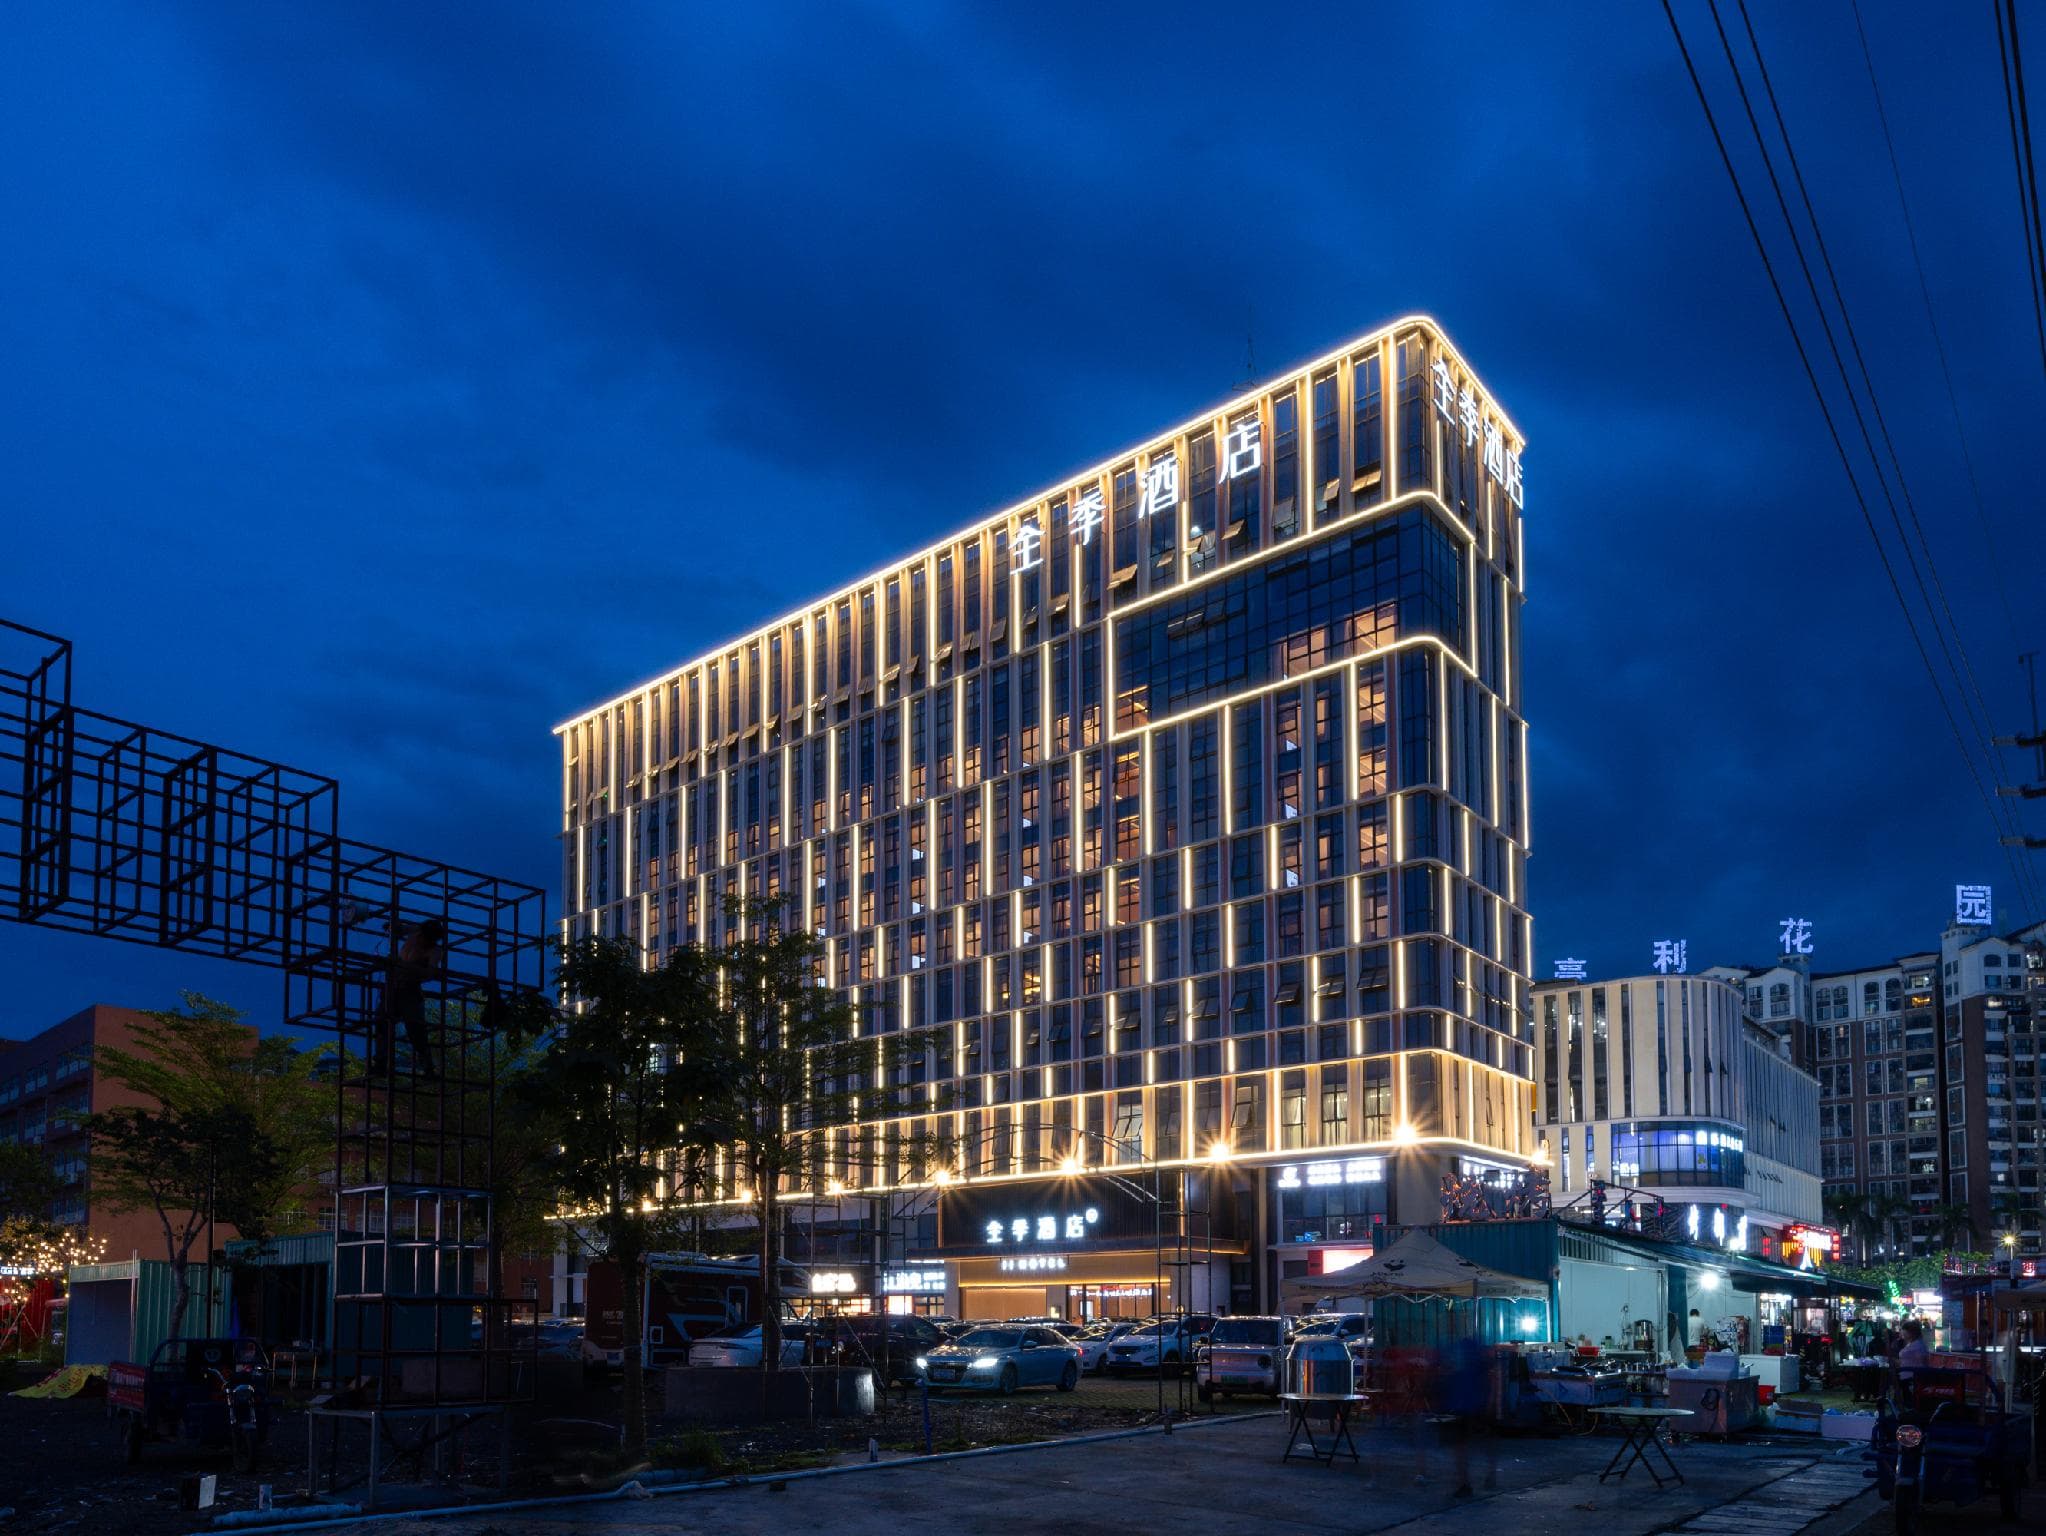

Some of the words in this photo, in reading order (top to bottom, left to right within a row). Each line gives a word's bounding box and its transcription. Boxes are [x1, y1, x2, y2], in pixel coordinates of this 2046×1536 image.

[1008, 421, 1261, 575] 全季酒店
[1431, 359, 1523, 509] 全季酒店
[986, 1214, 1084, 1243] 全季酒店
